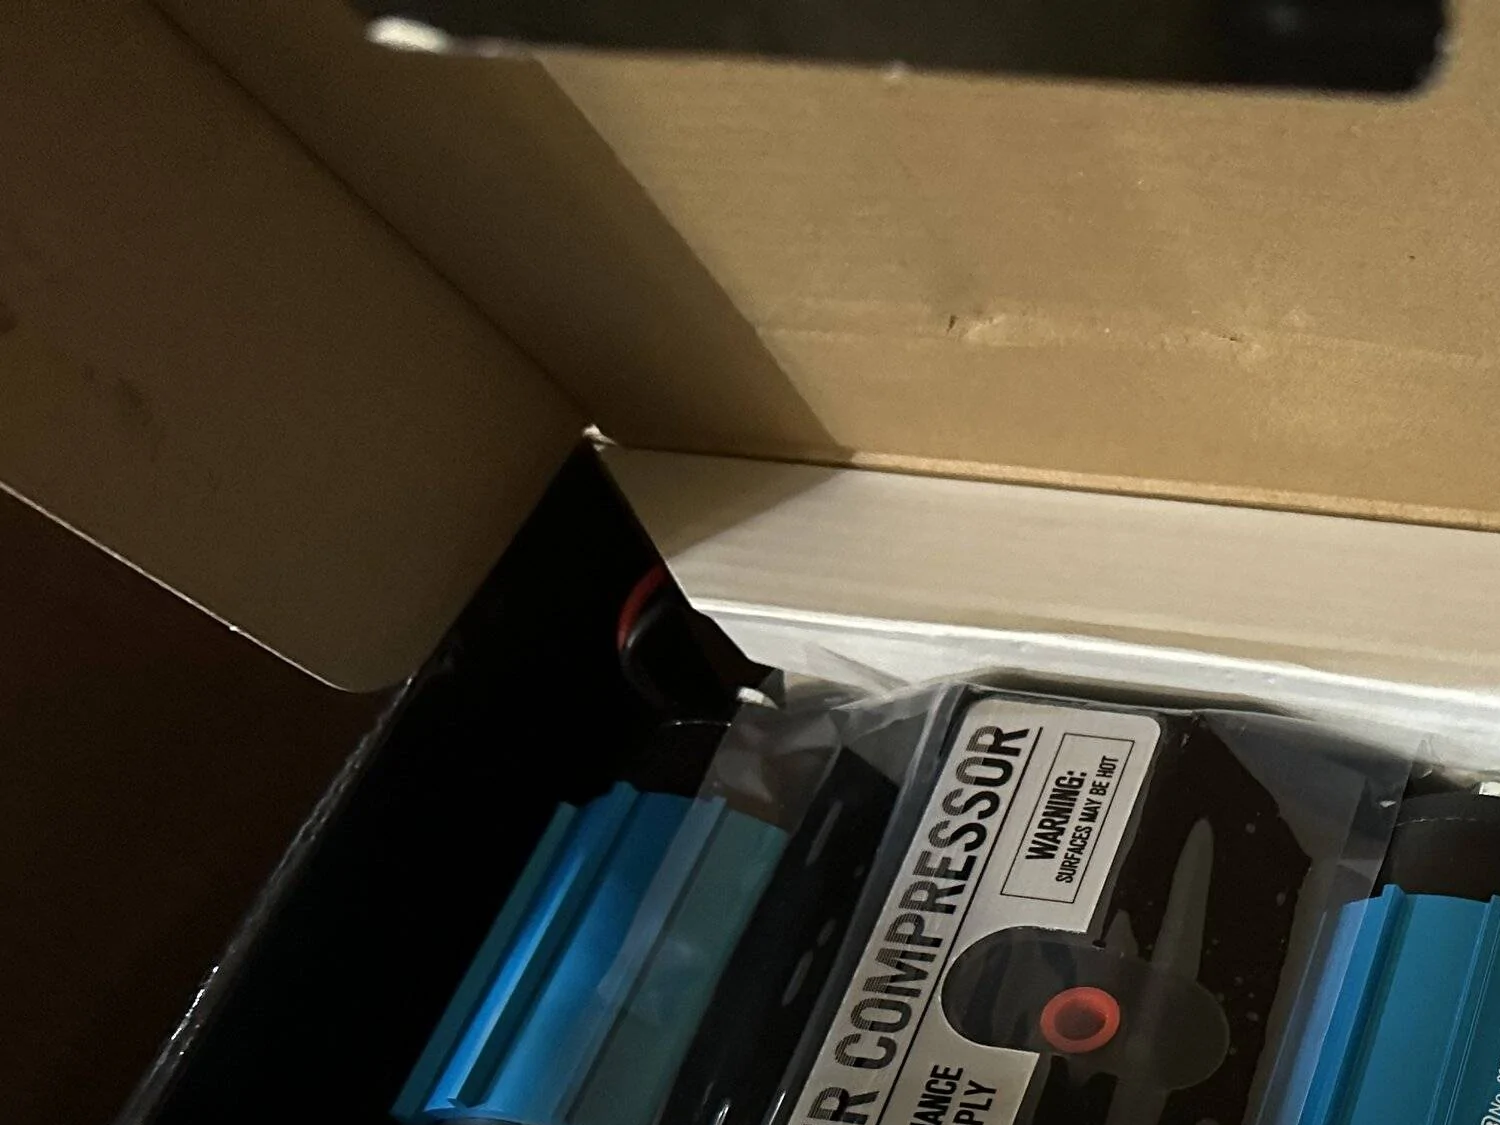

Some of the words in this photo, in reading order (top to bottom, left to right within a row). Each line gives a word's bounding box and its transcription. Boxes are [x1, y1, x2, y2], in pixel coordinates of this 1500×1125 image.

[1096, 755, 1119, 778] HOT
[1089, 780, 1110, 796] BE
[1025, 770, 1087, 859] WARNING:
[1079, 798, 1102, 823] MAY
[1055, 825, 1093, 883] SURFACES
[837, 724, 1030, 1070] COMPRESSOR
